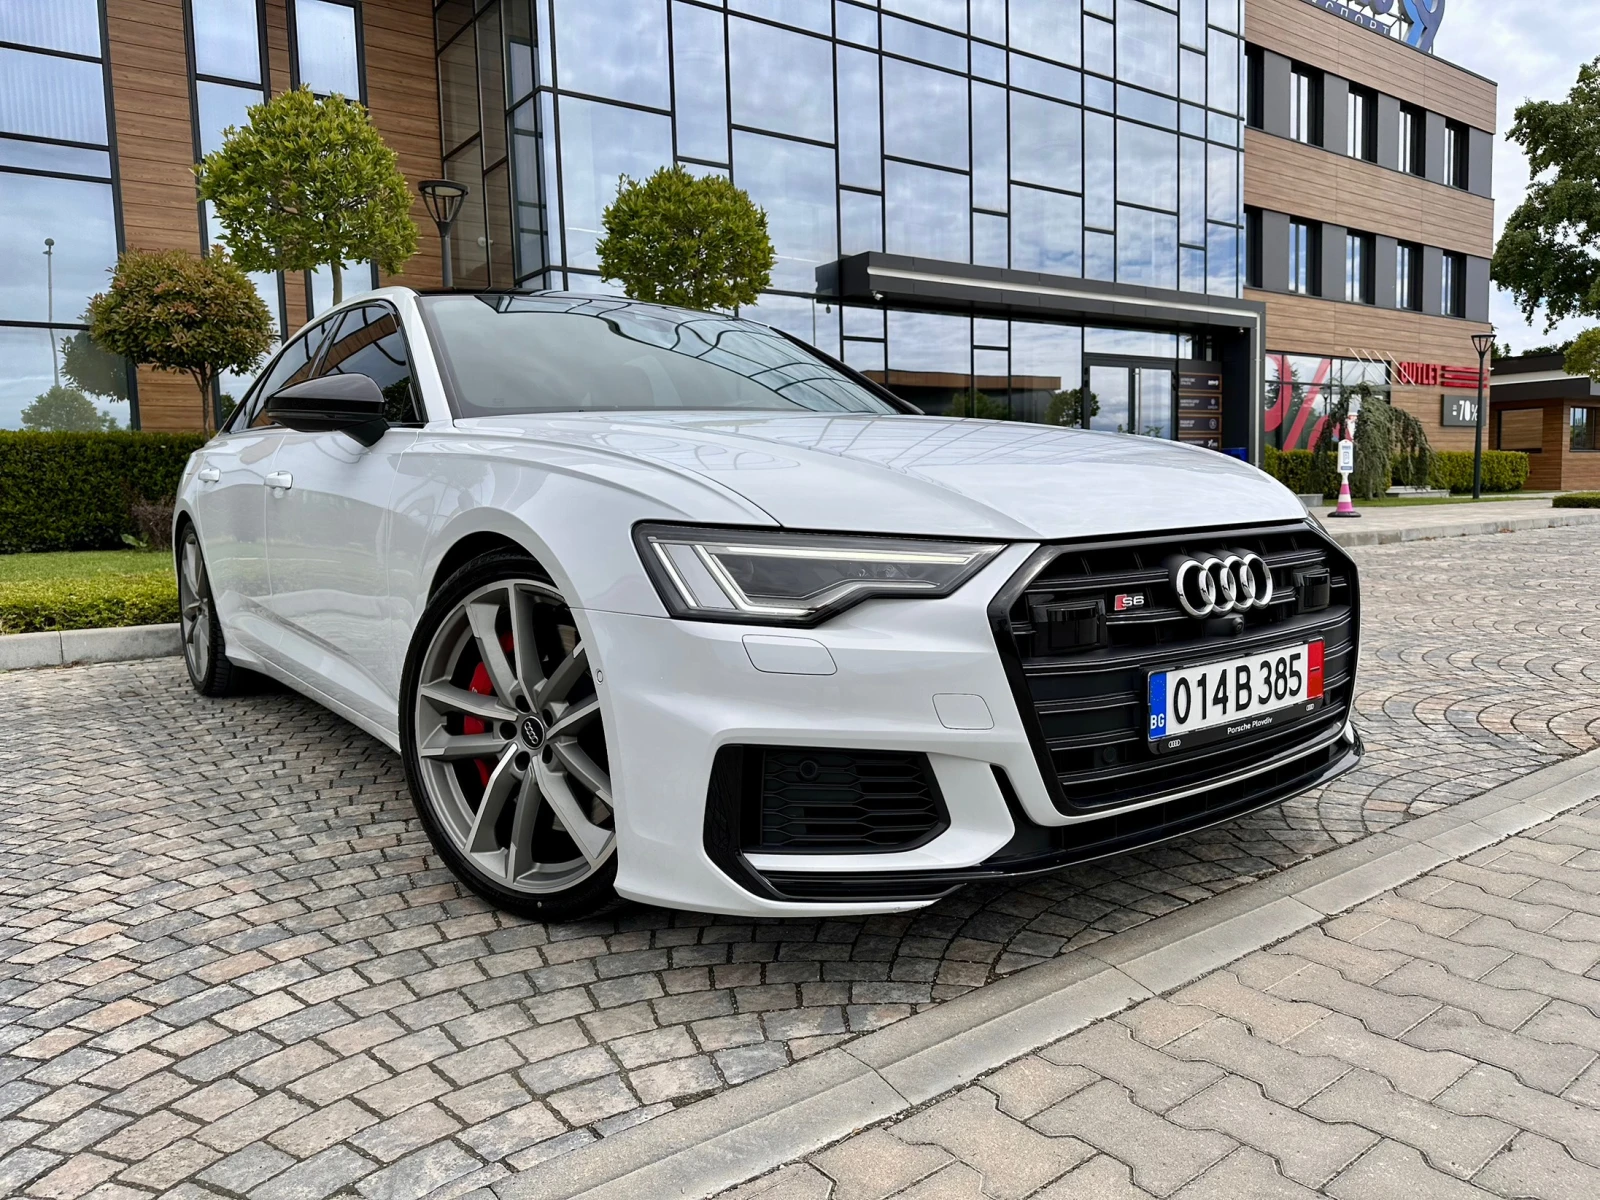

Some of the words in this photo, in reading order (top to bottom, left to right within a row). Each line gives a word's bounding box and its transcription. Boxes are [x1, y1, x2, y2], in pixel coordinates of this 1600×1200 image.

[1399, 361, 1441, 385] OUTLET
[1122, 595, 1144, 607] S6
[1151, 713, 1165, 729] BG
[1227, 722, 1251, 735] Porsche
[1251, 716, 1273, 729] Plovdiv
